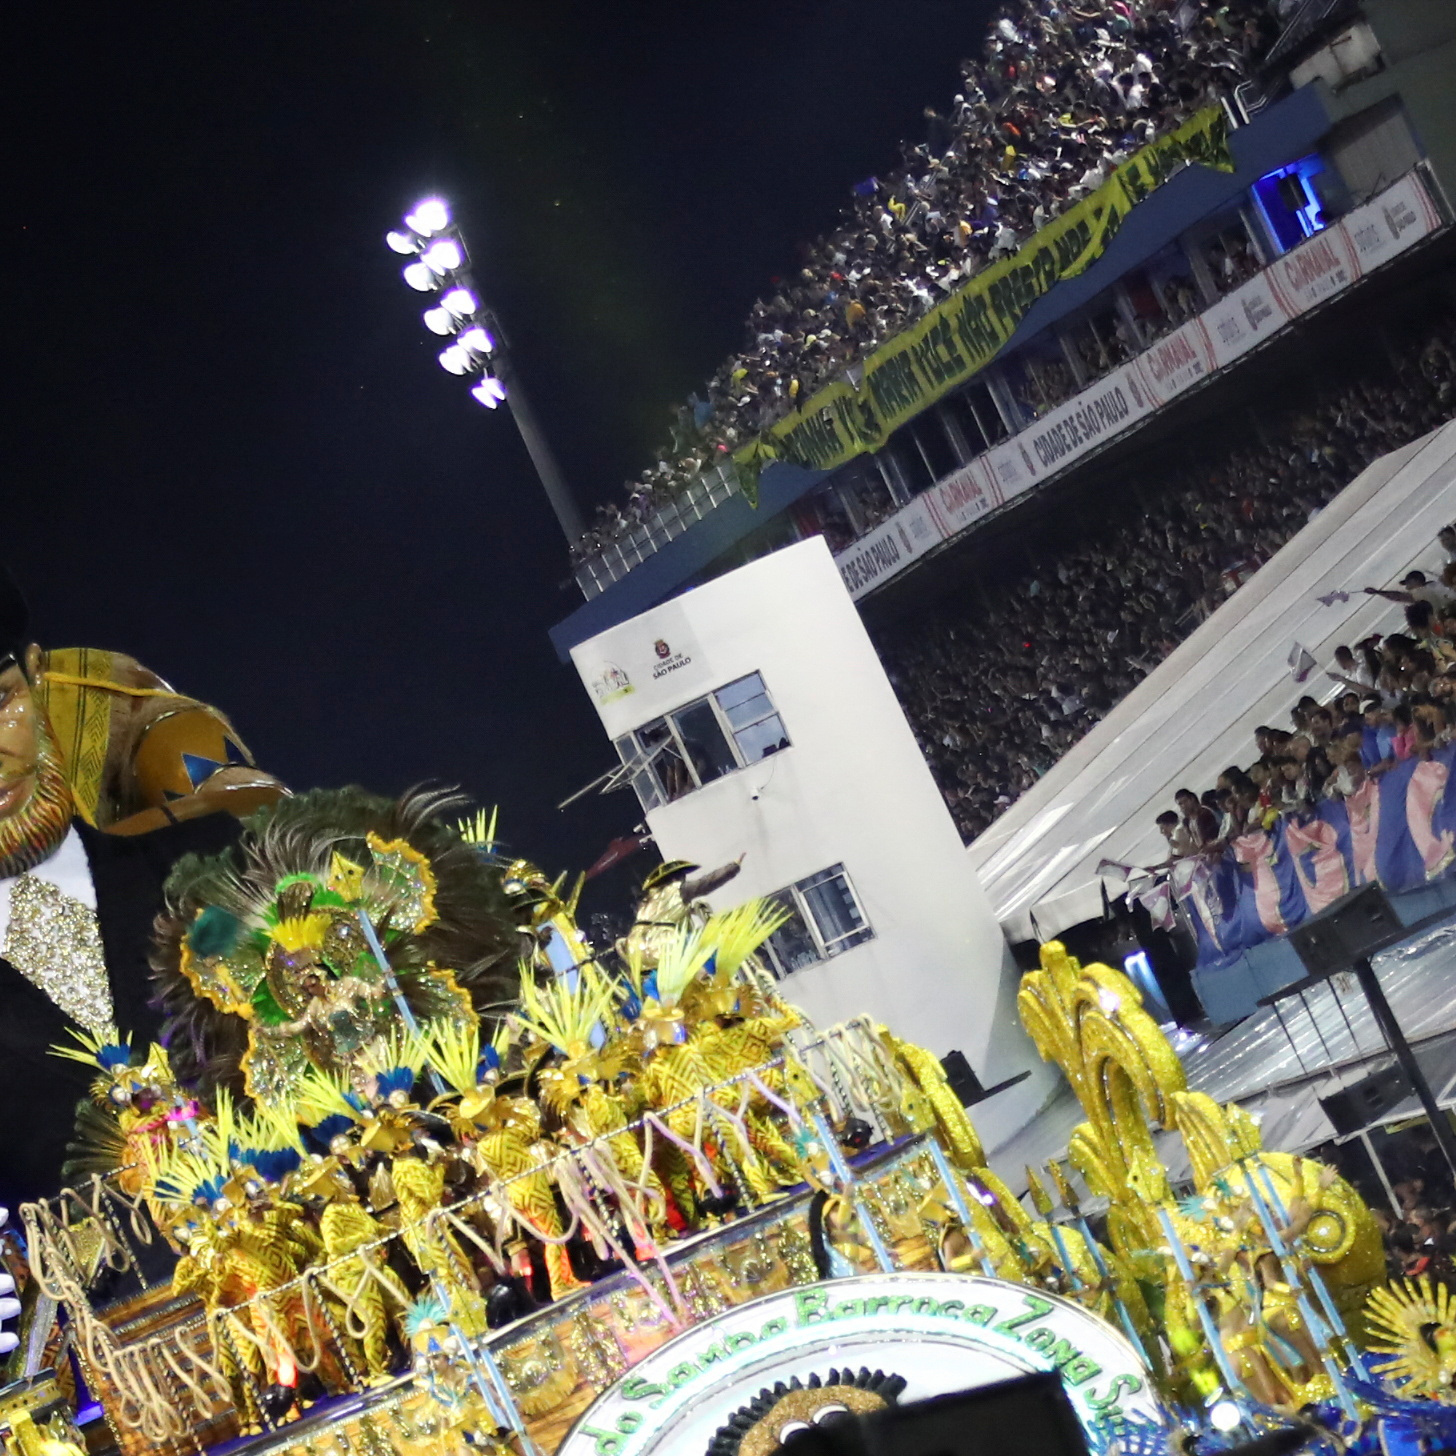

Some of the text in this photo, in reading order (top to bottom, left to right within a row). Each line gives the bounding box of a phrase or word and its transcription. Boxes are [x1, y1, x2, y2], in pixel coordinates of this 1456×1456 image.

[1033, 424, 1072, 467] CIDADE
[1063, 415, 1083, 448] DE
[1094, 386, 1129, 430] PAULO
[667, 656, 692, 673] PAULO
[794, 1287, 998, 1330] Barroca
